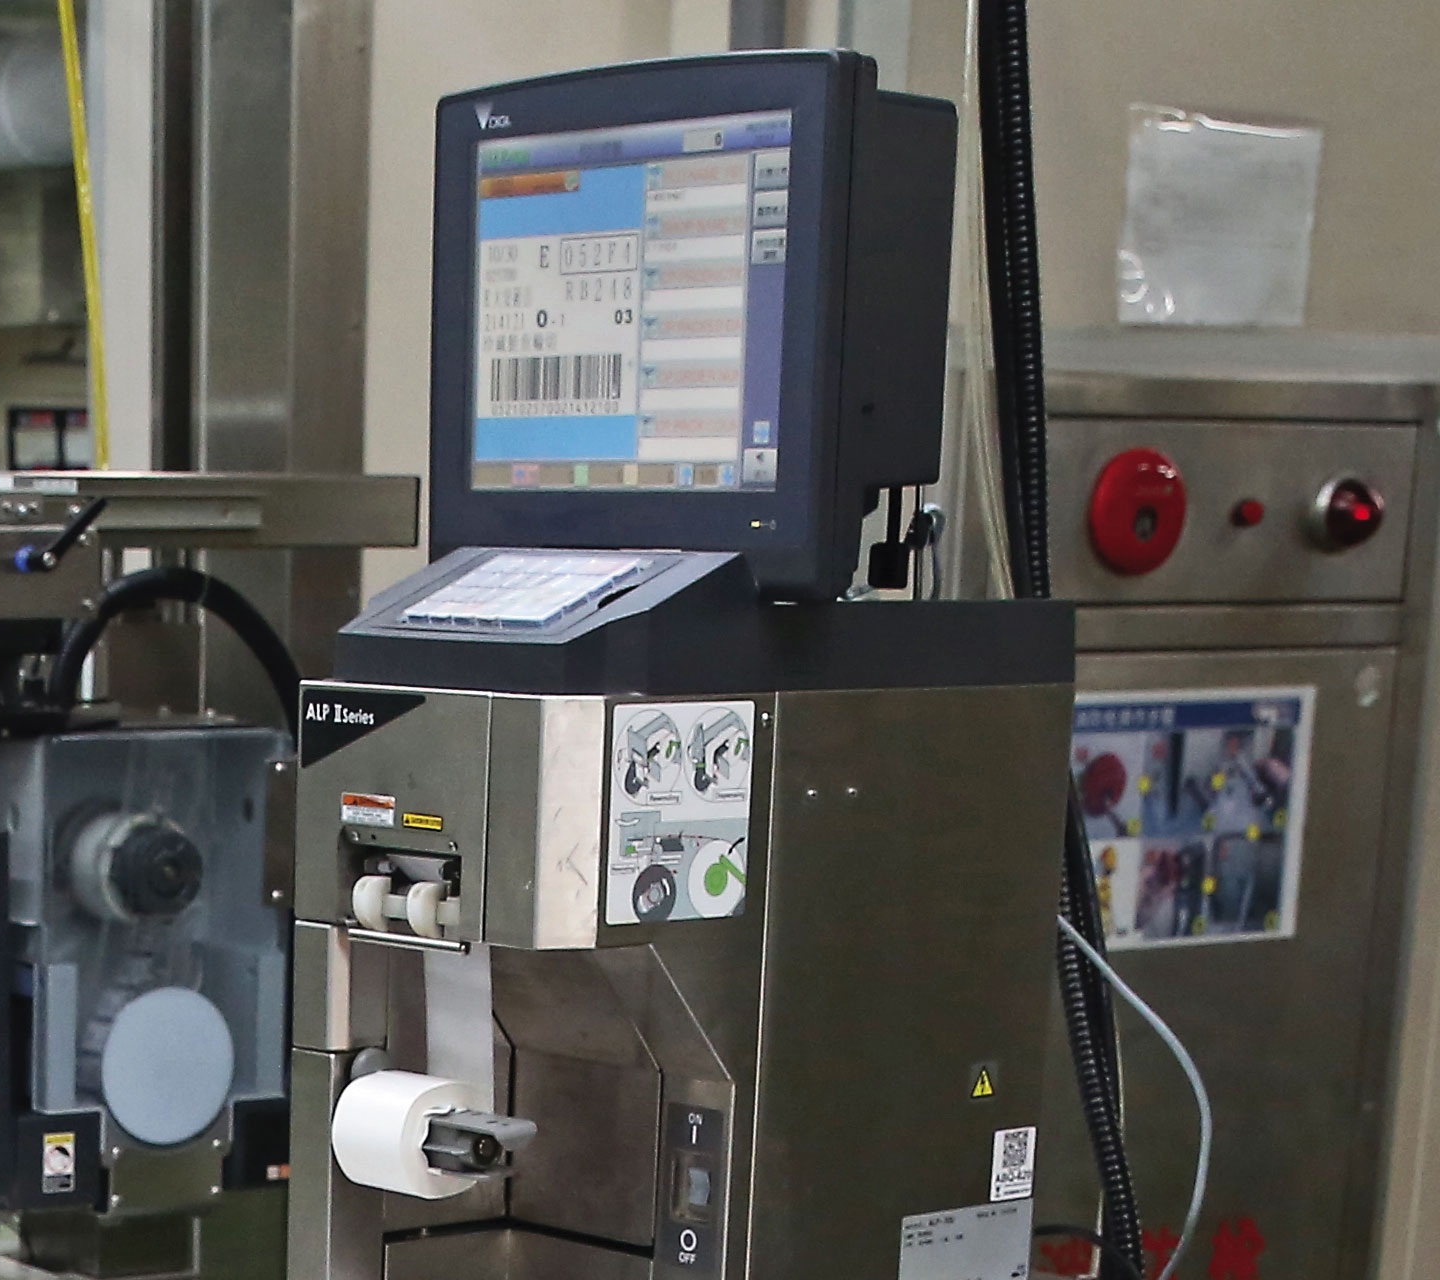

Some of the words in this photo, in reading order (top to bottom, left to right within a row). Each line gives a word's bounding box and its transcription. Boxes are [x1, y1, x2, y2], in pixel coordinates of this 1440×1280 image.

[539, 244, 549, 268] E
[306, 703, 330, 721] ALP
[688, 1112, 703, 1125] ON
[678, 1252, 697, 1265] OFF
